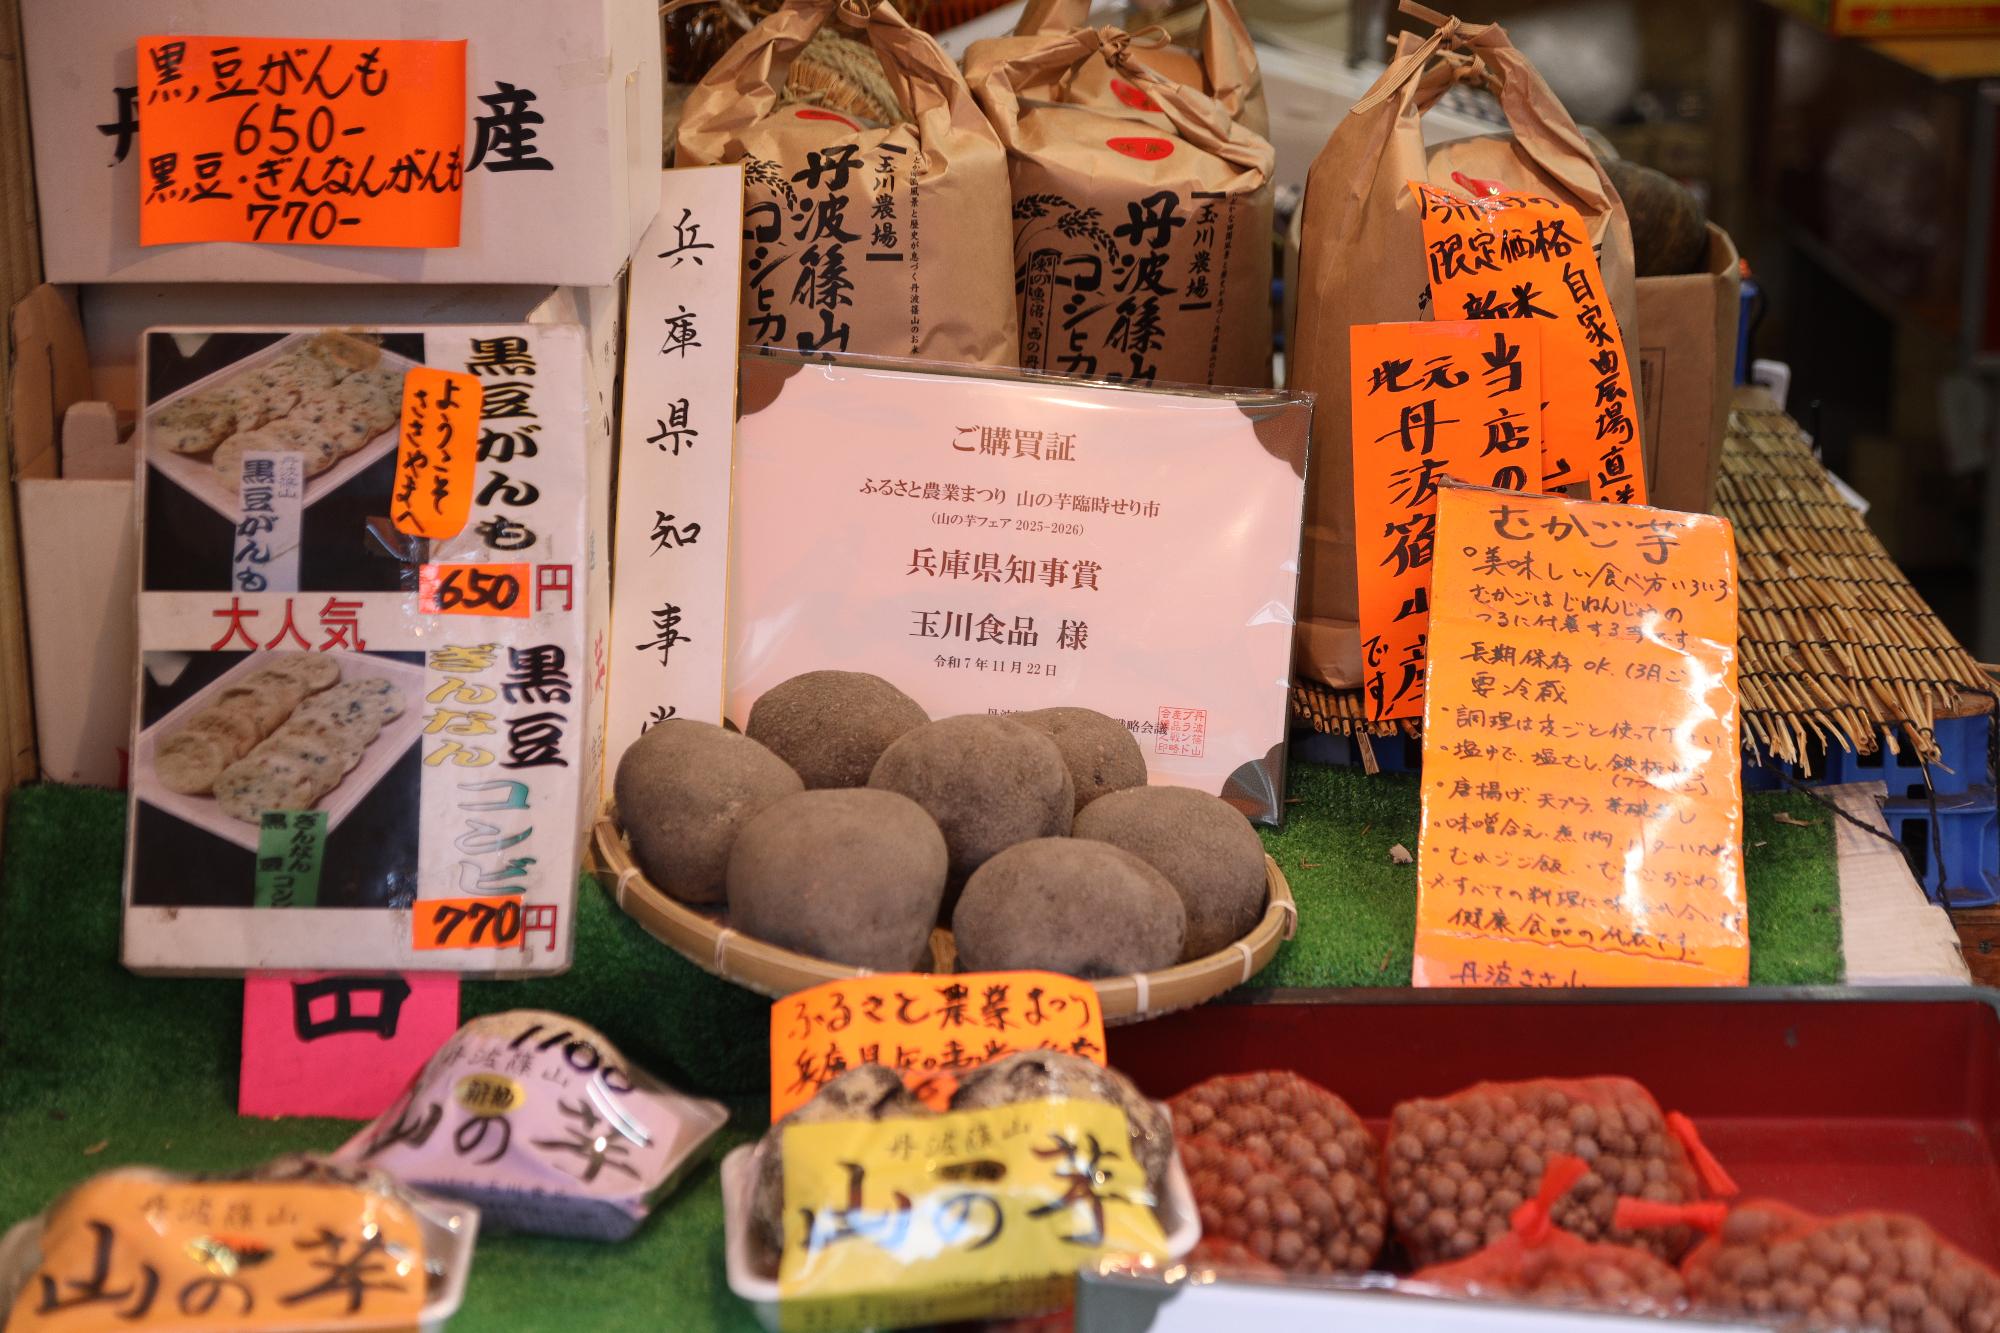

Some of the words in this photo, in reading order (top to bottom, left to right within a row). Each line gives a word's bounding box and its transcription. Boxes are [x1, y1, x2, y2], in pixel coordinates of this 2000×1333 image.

[147, 40, 390, 104] 黒豆がんも
[870, 154, 898, 249] 玉川農場
[1186, 203, 1219, 298] 玉川農場
[1429, 220, 1583, 285] 限定価格
[466, 335, 541, 552] 黒豆がんも
[952, 424, 1079, 461] ご購買証
[859, 477, 1007, 504] ふるさと農業まつり
[1016, 490, 1161, 519] 山の芋臨時せり市
[1489, 504, 1686, 566] むかご芋
[906, 547, 1103, 592] 兵庫県知事賞
[210, 596, 366, 652] 大人気
[908, 609, 1039, 648] 玉川食品
[1056, 618, 1090, 651] 様
[1460, 641, 1573, 672] 長期保存
[1471, 673, 1568, 704] 要冷蔵
